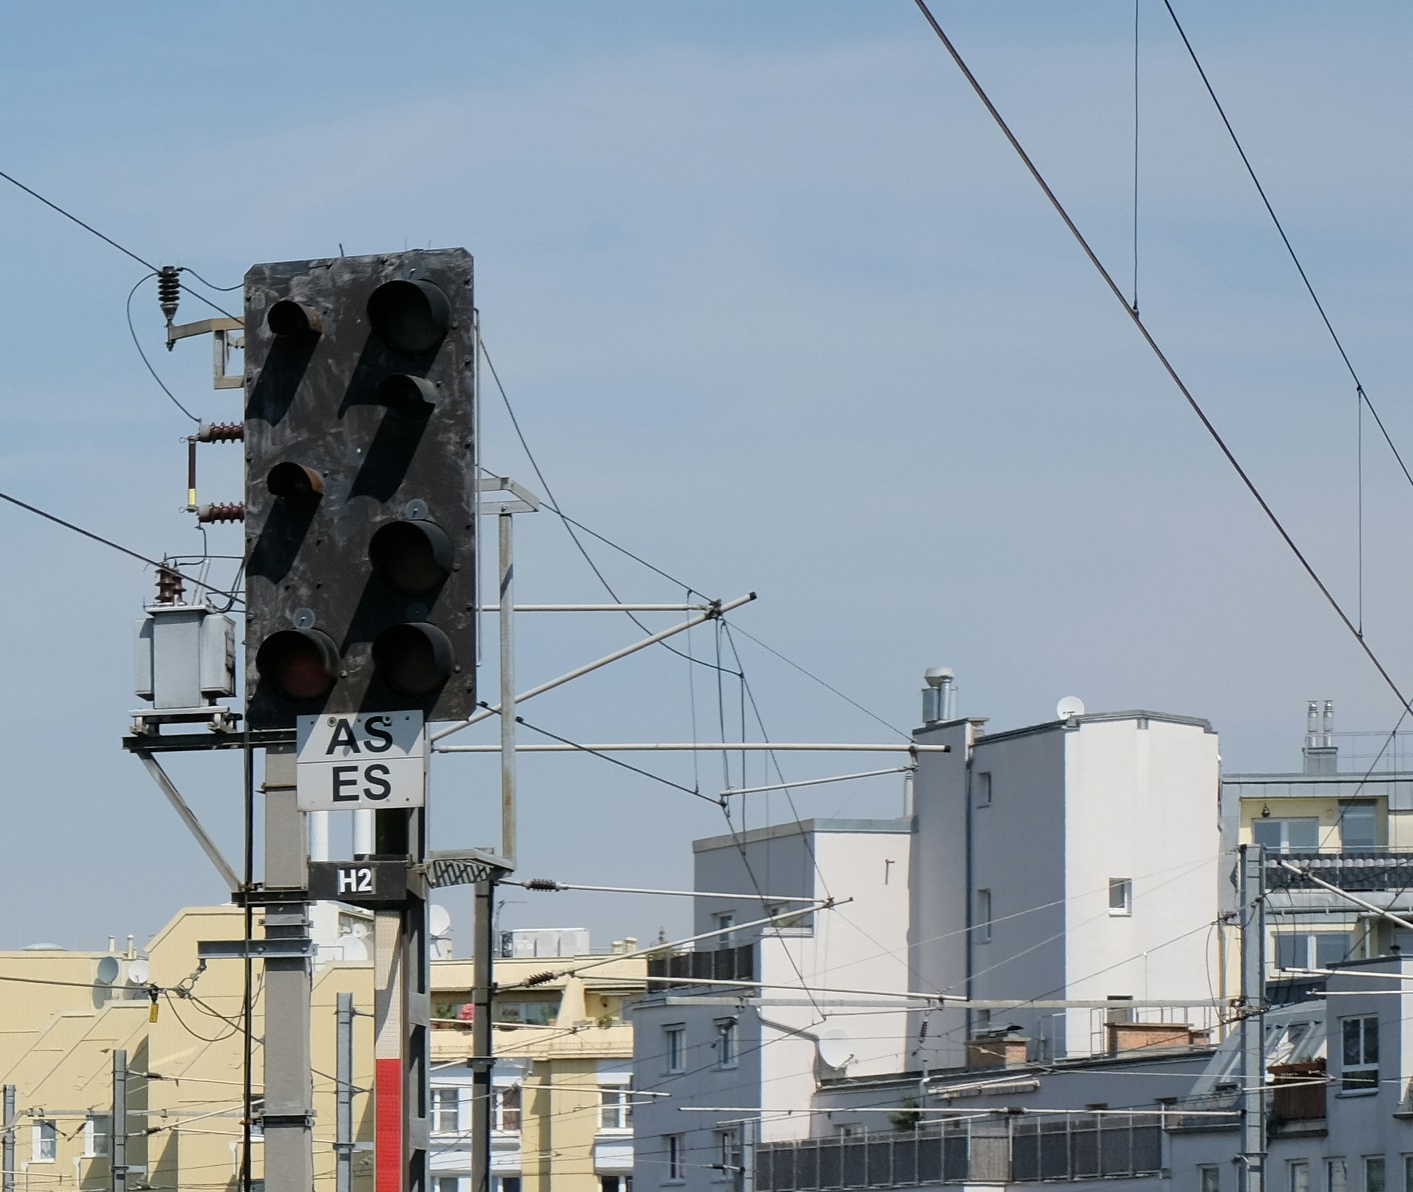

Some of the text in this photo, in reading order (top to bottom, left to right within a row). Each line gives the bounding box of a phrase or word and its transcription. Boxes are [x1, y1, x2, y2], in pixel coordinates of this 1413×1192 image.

[325, 715, 394, 755] AS
[331, 763, 392, 802] ES
[338, 868, 373, 893] H2
